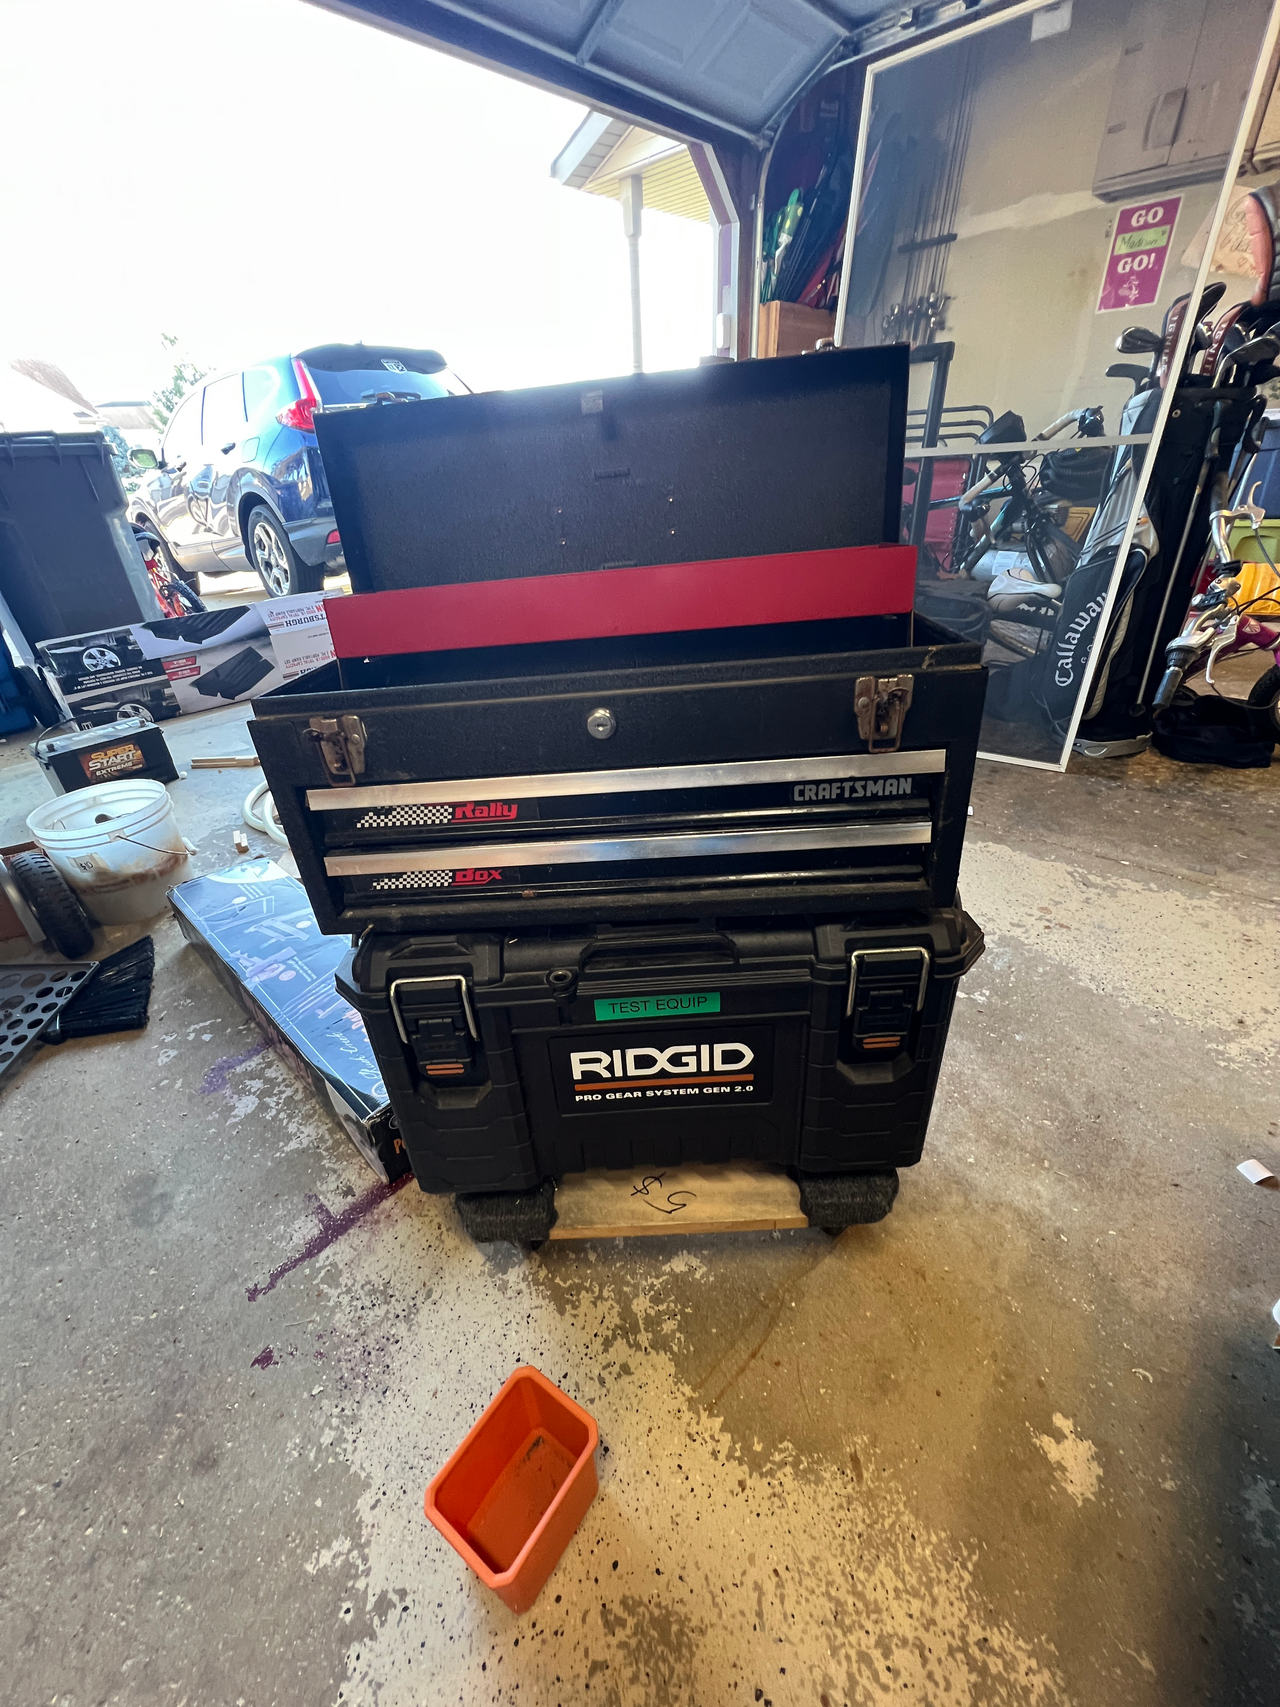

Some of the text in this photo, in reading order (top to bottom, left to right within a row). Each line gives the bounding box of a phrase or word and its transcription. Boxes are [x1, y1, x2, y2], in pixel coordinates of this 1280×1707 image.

[1131, 206, 1164, 227] GO
[1117, 253, 1156, 274] GO!
[285, 613, 326, 627] TSBURGH
[88, 750, 136, 771] START
[91, 744, 135, 760] SUPER
[95, 762, 133, 776] EXTREME
[792, 776, 913, 802] CRAFTSMAN
[452, 801, 519, 823] Rally
[608, 996, 708, 1014] TEST EQUIP
[570, 1042, 755, 1080] RIDGID
[575, 1084, 753, 1102] PRO GEAR SYSTEM GEN 2.0
